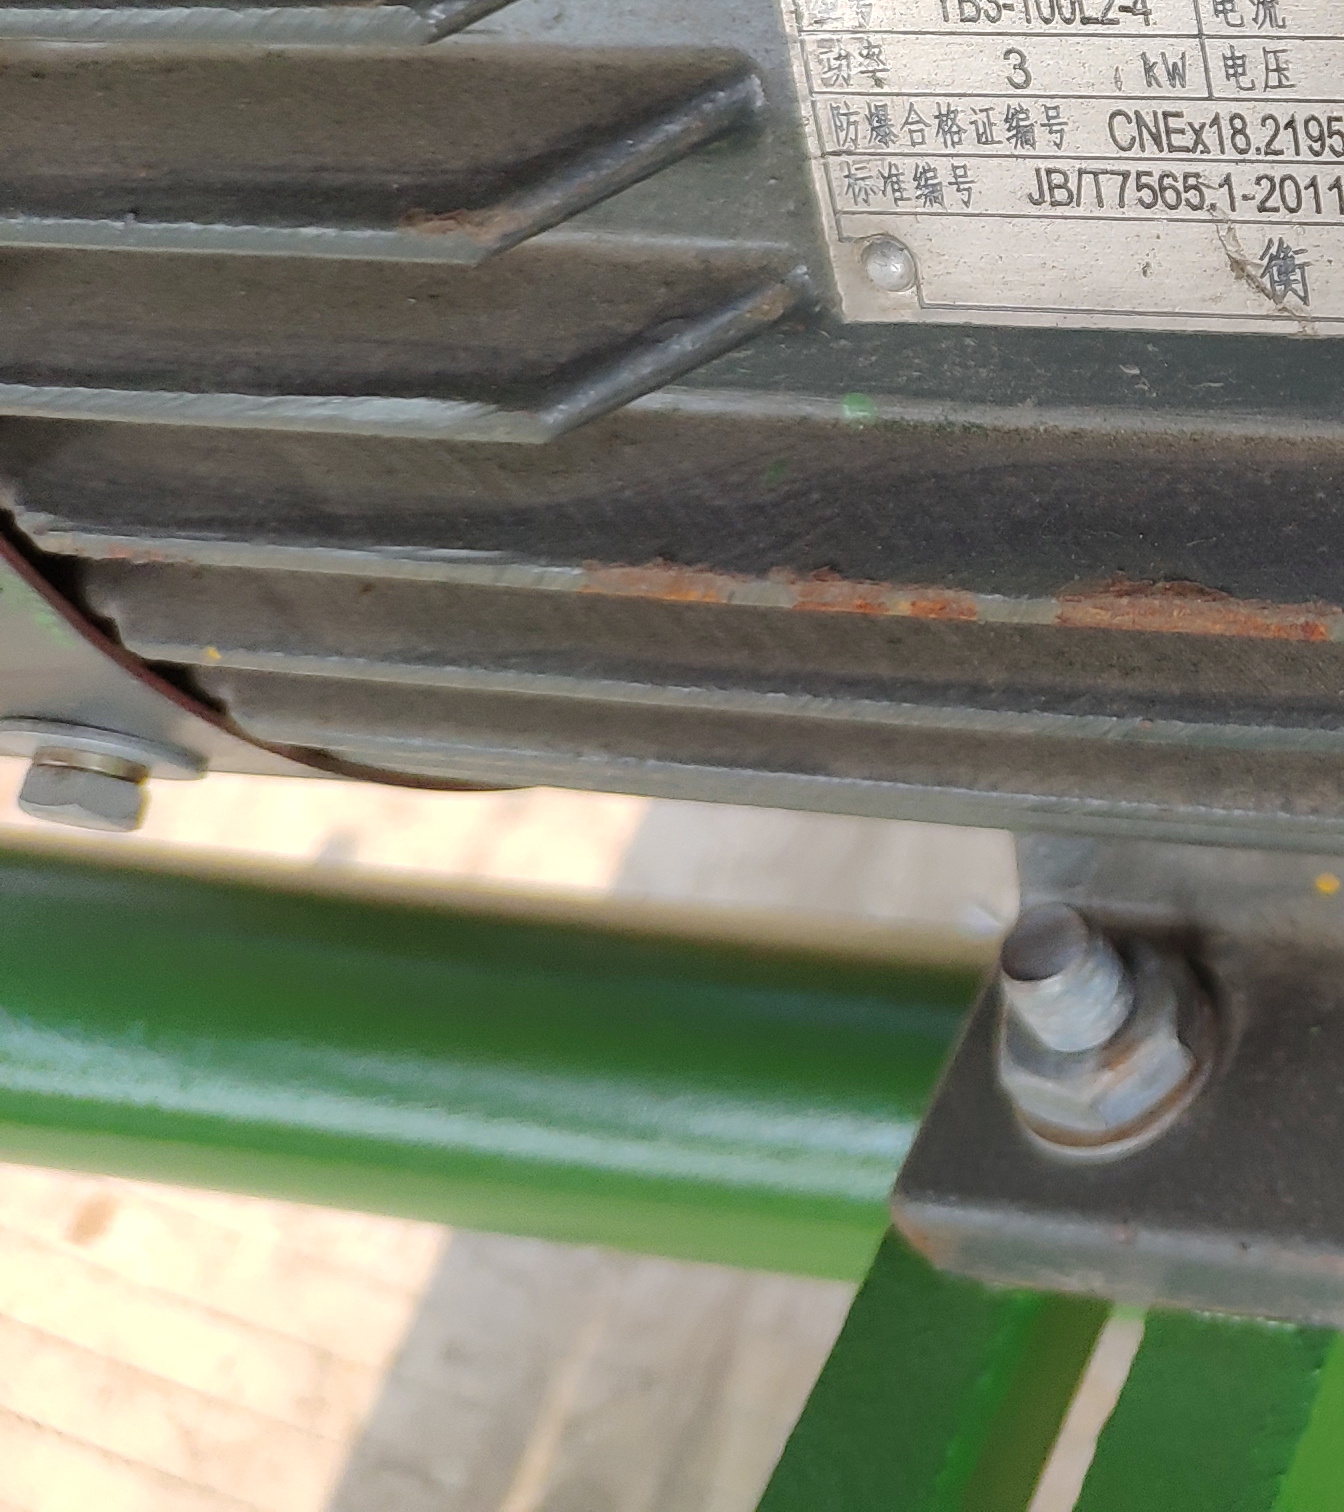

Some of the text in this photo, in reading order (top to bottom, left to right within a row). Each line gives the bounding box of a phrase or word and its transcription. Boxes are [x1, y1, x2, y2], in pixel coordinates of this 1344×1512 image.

[1002, 46, 1033, 90] 3
[1222, 44, 1297, 93] 电压
[831, 101, 1067, 152] 防爆合格证编号
[844, 160, 978, 210] 标准编号
